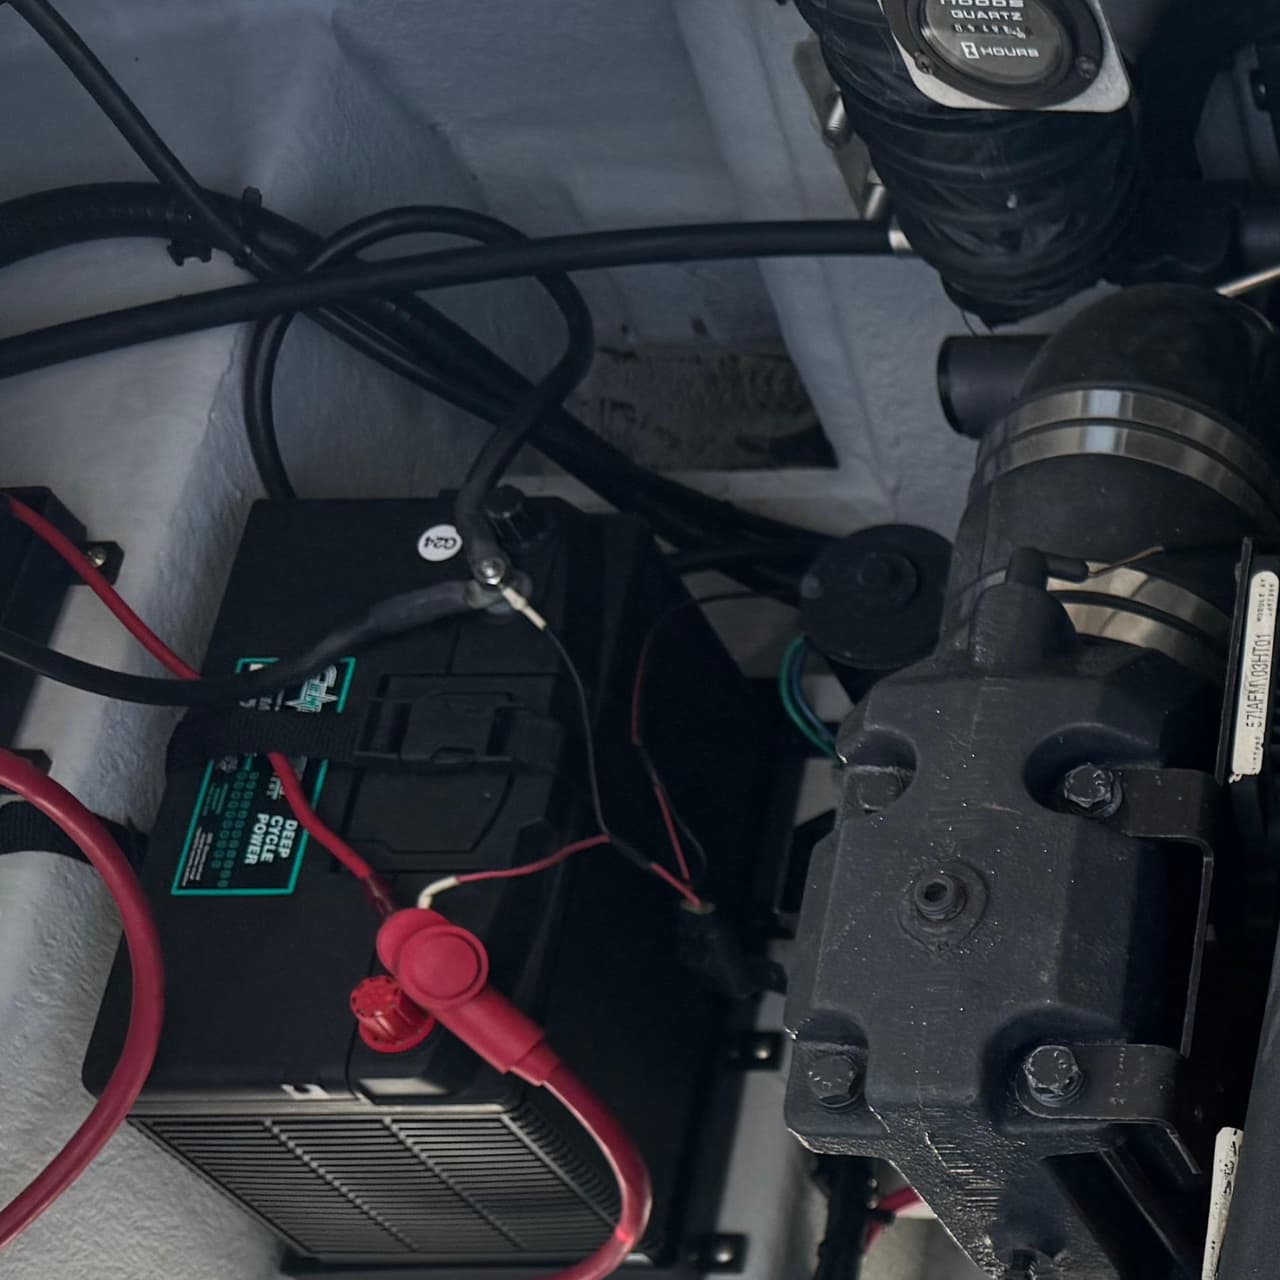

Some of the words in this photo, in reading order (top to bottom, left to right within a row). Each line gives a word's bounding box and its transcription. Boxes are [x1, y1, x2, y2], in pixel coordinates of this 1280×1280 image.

[951, 9, 1023, 21] QUARTZ
[980, 45, 1039, 57] HOURS
[244, 812, 270, 865] POWER
[260, 814, 284, 863] CYCLE
[281, 819, 299, 859] DEEP
